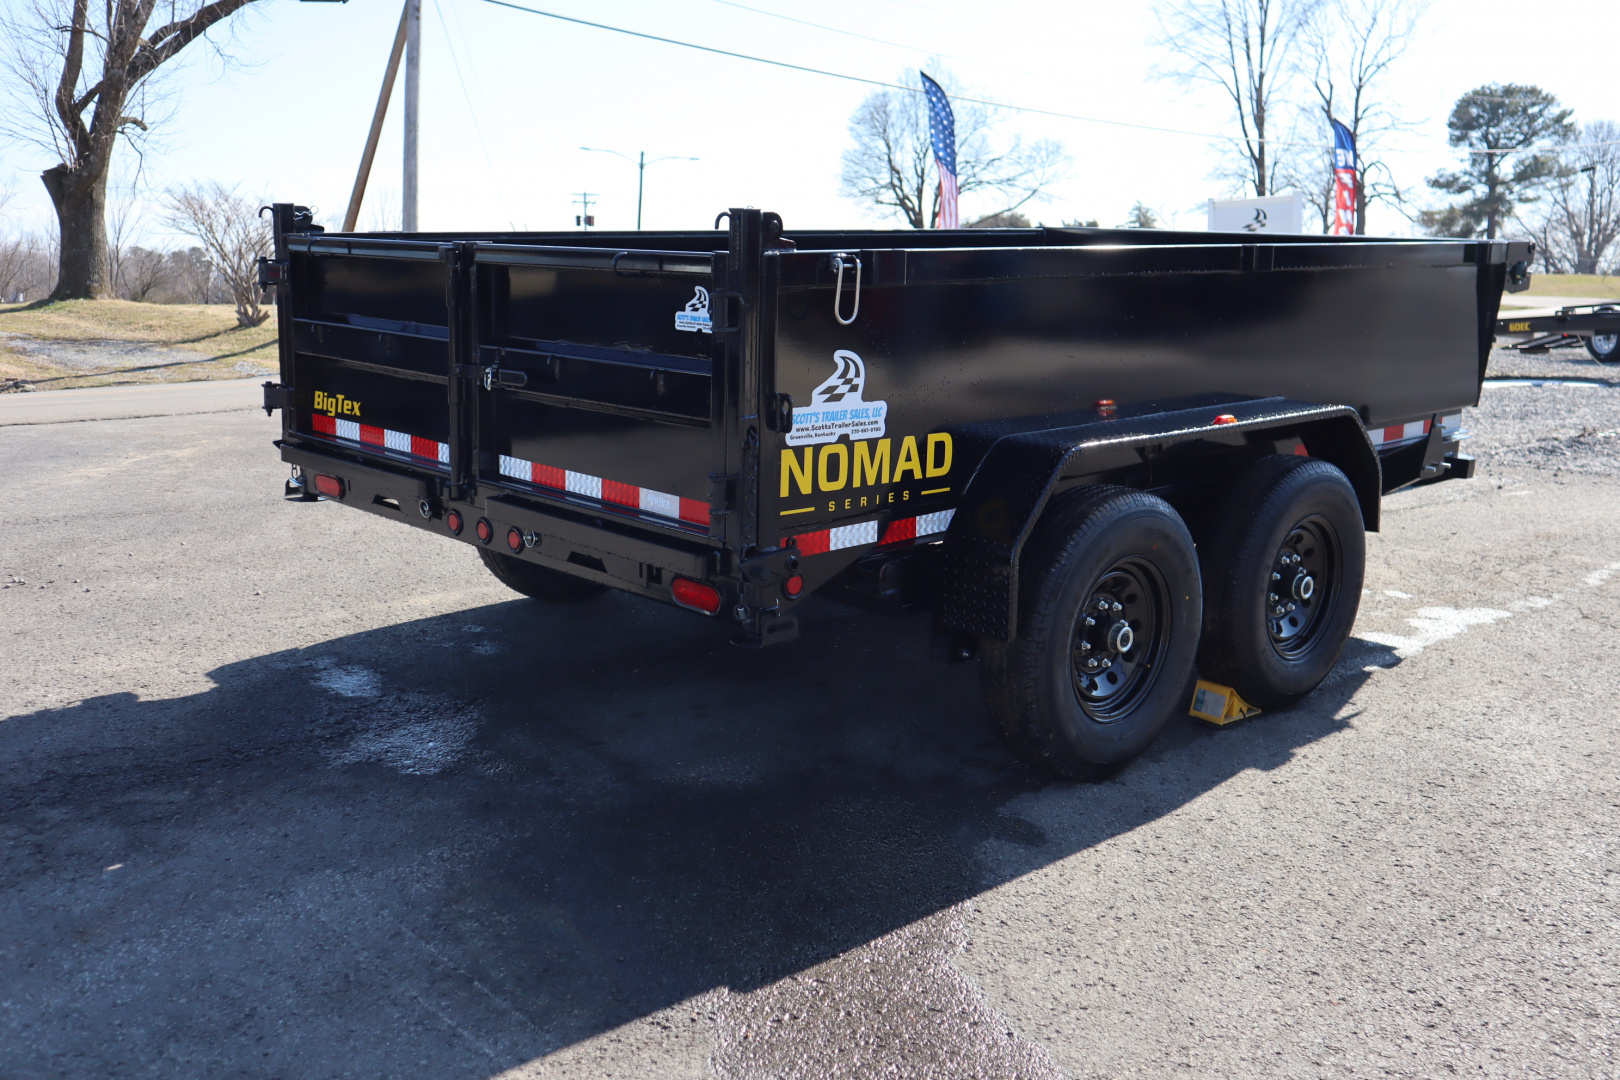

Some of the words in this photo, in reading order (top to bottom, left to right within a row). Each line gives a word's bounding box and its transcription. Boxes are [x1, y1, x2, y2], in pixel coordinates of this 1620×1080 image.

[314, 390, 361, 417] BigTex
[792, 412, 820, 425] SCOTT'S
[821, 410, 848, 422] TRAILER
[849, 407, 870, 420] SALES,
[872, 407, 883, 417] LLC
[796, 420, 879, 432] www.ScottsTrailerSales.com
[780, 432, 953, 498] NOMAD
[828, 490, 910, 511] SERIES
